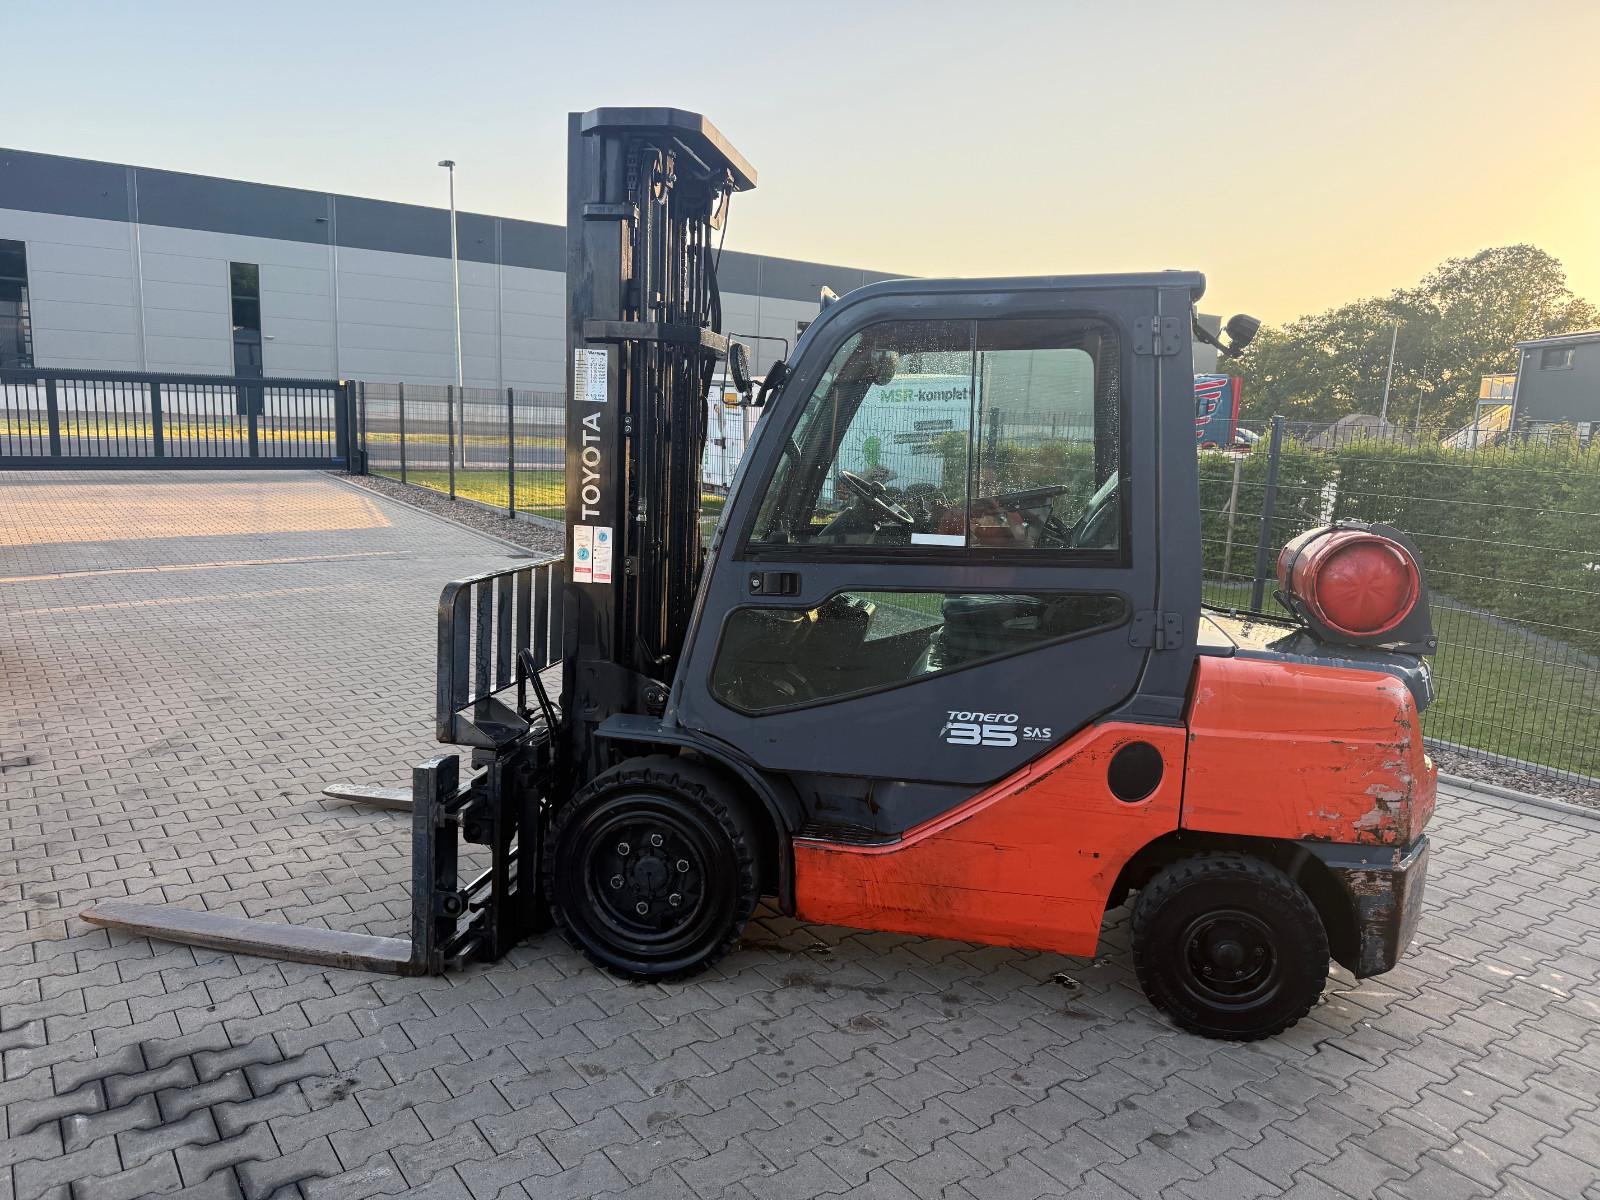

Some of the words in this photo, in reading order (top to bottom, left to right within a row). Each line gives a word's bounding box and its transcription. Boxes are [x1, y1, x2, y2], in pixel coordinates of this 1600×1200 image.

[581, 411, 601, 520] TOYOTA
[941, 721, 1018, 747] 35
[1023, 727, 1052, 738] SAS
